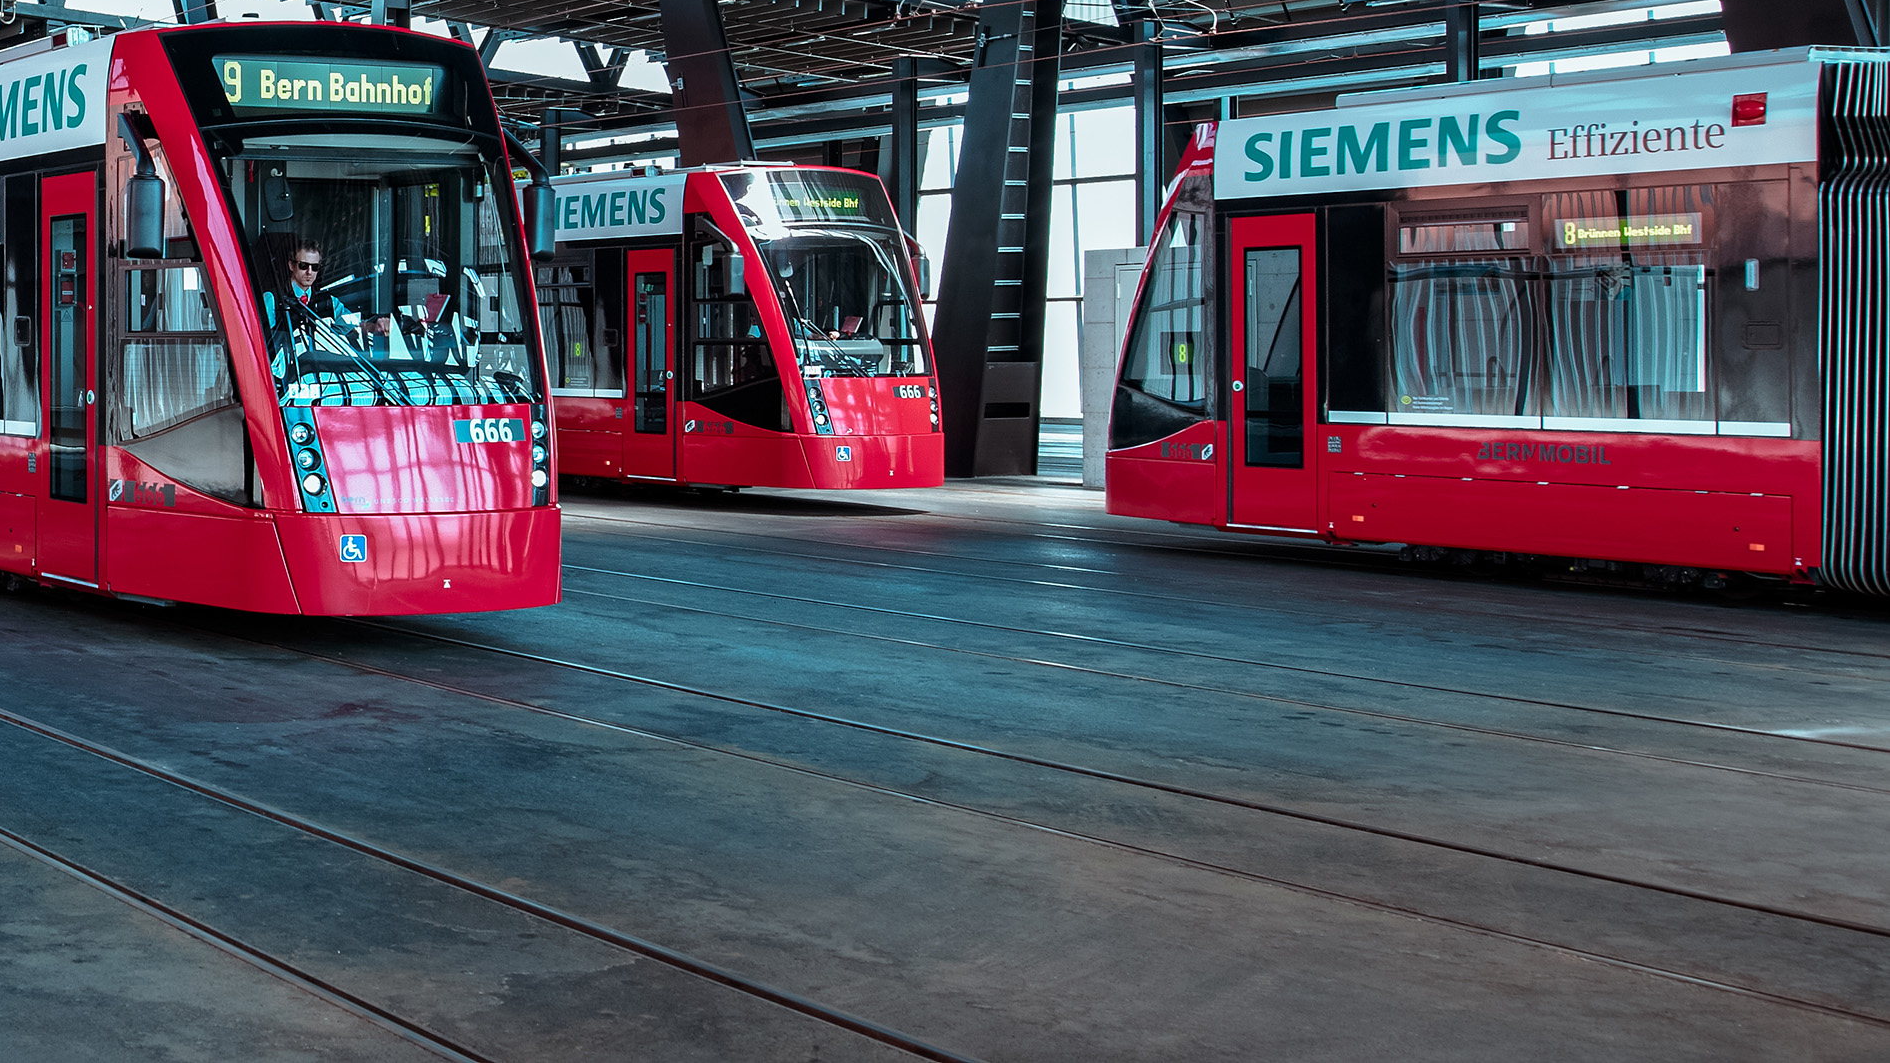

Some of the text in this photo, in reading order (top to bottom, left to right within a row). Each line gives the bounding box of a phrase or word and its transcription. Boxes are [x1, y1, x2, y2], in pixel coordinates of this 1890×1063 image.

[223, 61, 433, 105] 9 Bern Bahnhof
[1243, 109, 1726, 183] SIEMENS Effiziente
[554, 187, 667, 230] IEMENS
[843, 197, 859, 209] Bhf
[1564, 222, 1693, 245] 8 Brünnen Westside Bhf
[575, 342, 581, 356] 8
[1178, 343, 1187, 363] 8
[898, 384, 922, 399] 666
[469, 417, 514, 443] 666
